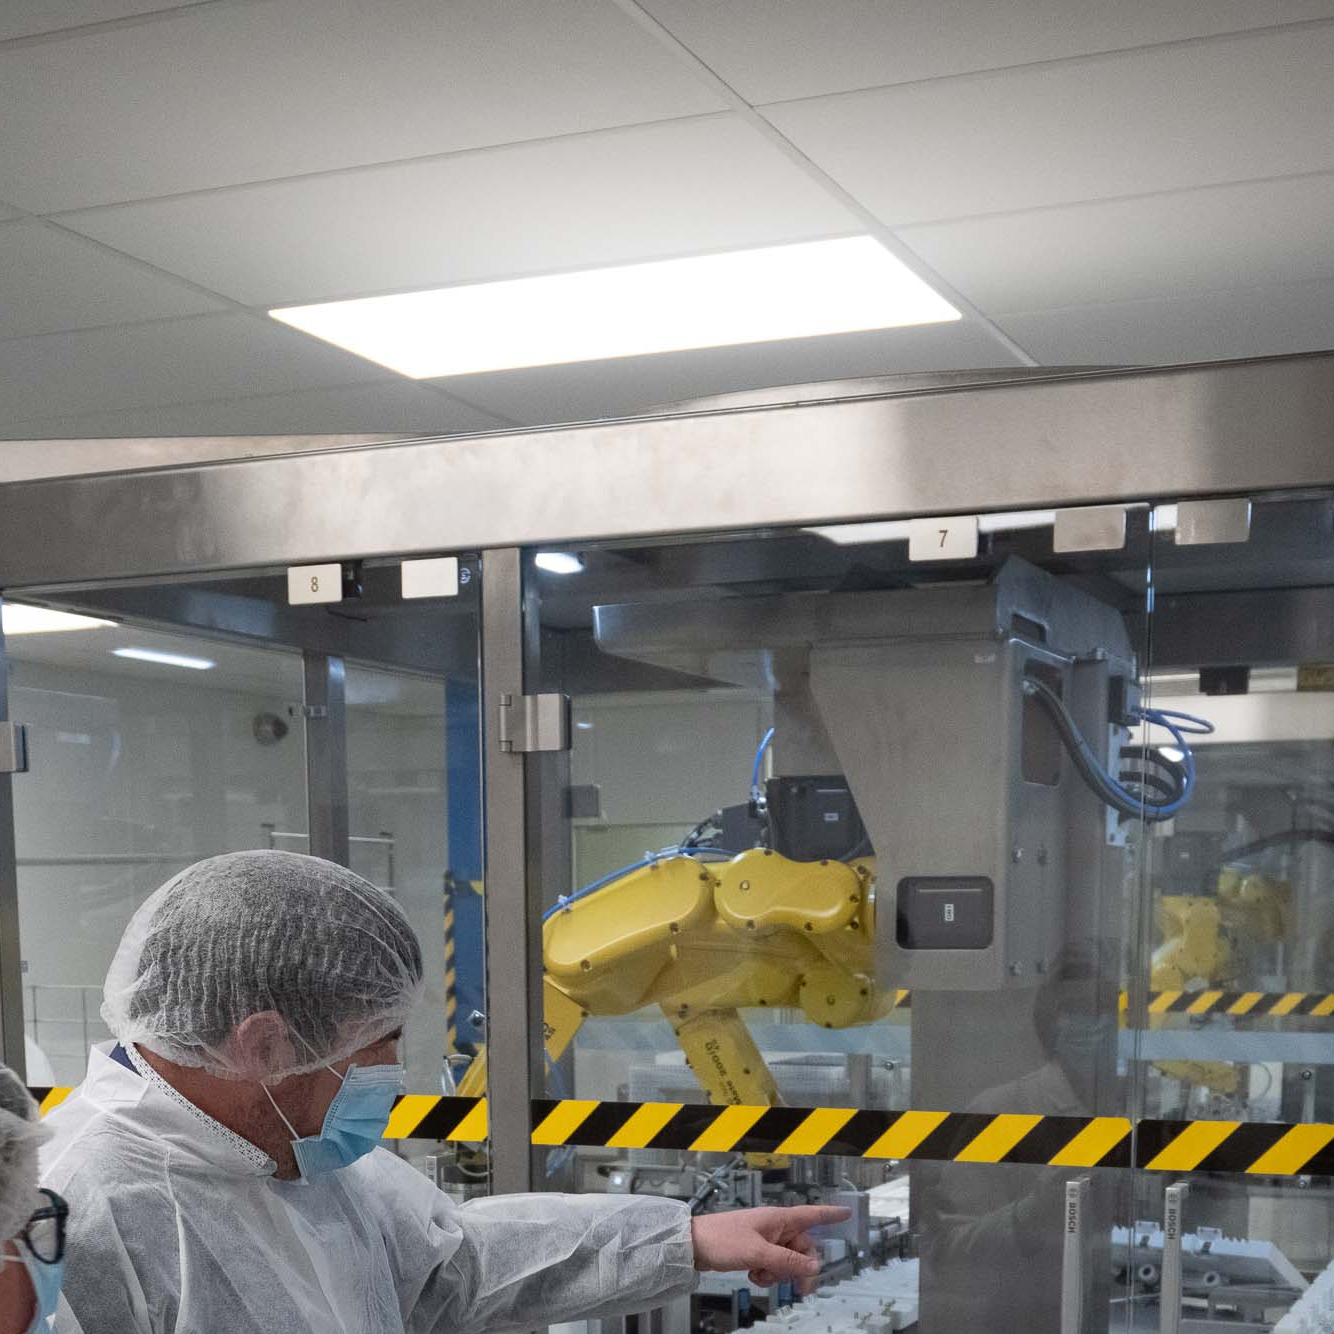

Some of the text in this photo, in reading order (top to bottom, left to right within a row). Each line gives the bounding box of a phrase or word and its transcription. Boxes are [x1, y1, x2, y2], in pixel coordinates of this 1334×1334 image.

[938, 529, 948, 548] 7
[310, 576, 320, 593] 8
[1068, 1202, 1076, 1234] BOSCH
[1168, 1208, 1177, 1240] BOSCH
